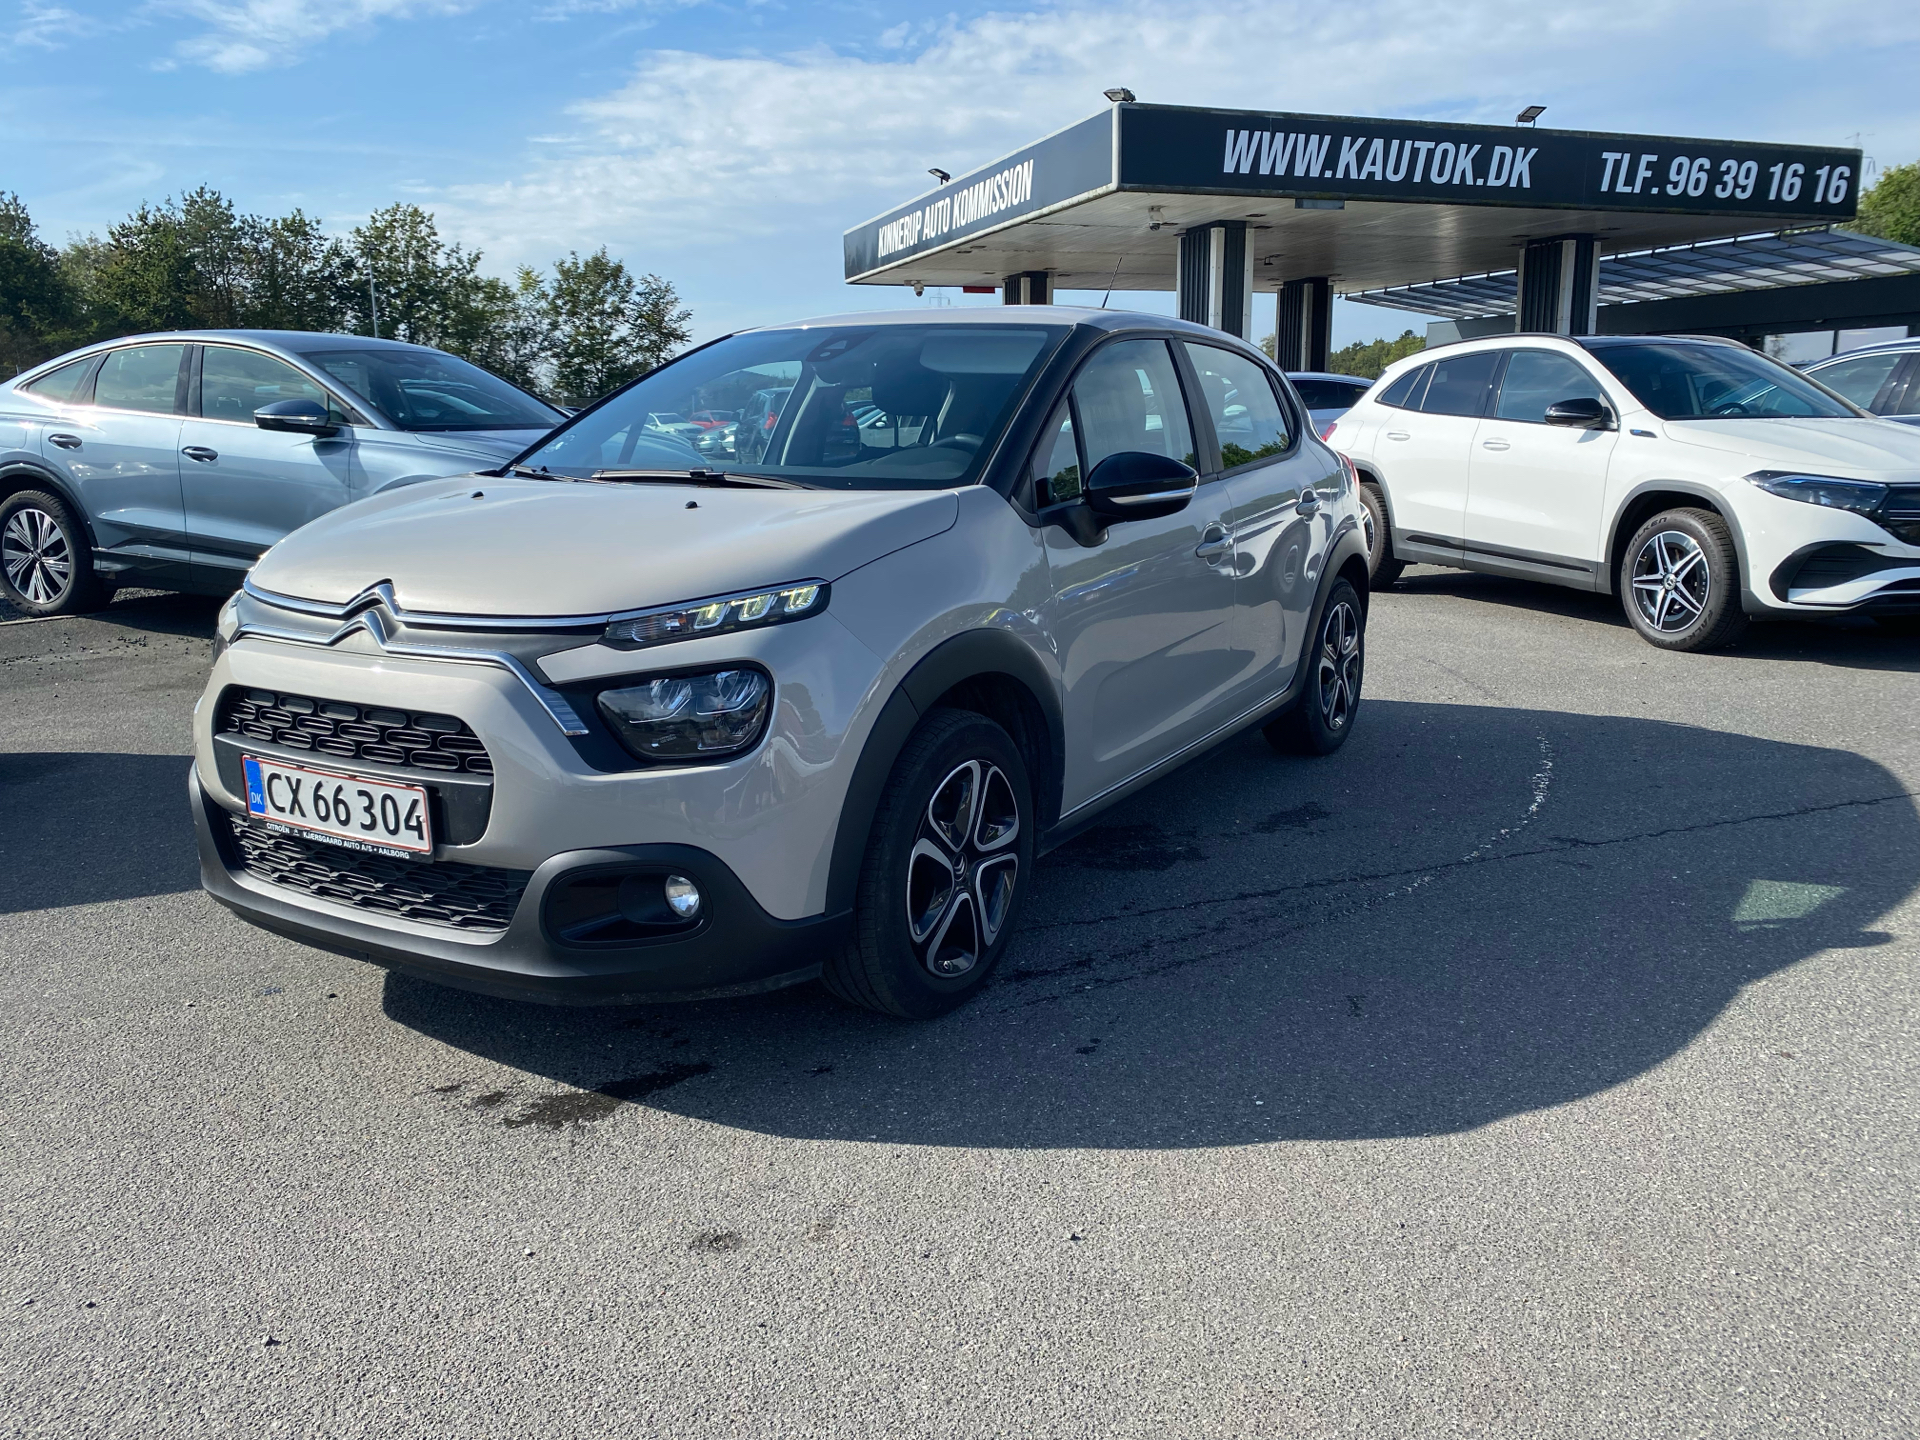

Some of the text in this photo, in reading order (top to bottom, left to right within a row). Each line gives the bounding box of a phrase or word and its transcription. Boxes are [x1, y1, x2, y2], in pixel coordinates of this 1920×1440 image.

[1223, 129, 1538, 189] WWW.KAUTOK.DK
[1600, 151, 1851, 204] TLF. 96 39 16 16
[878, 158, 1034, 258] KINNERUP AUTO KOMMISSION
[251, 792, 262, 806] DK
[266, 772, 425, 841] CX 66 304
[344, 839, 361, 850] AUTO
[361, 843, 373, 852] A/S
[378, 848, 410, 859] AALBORG
